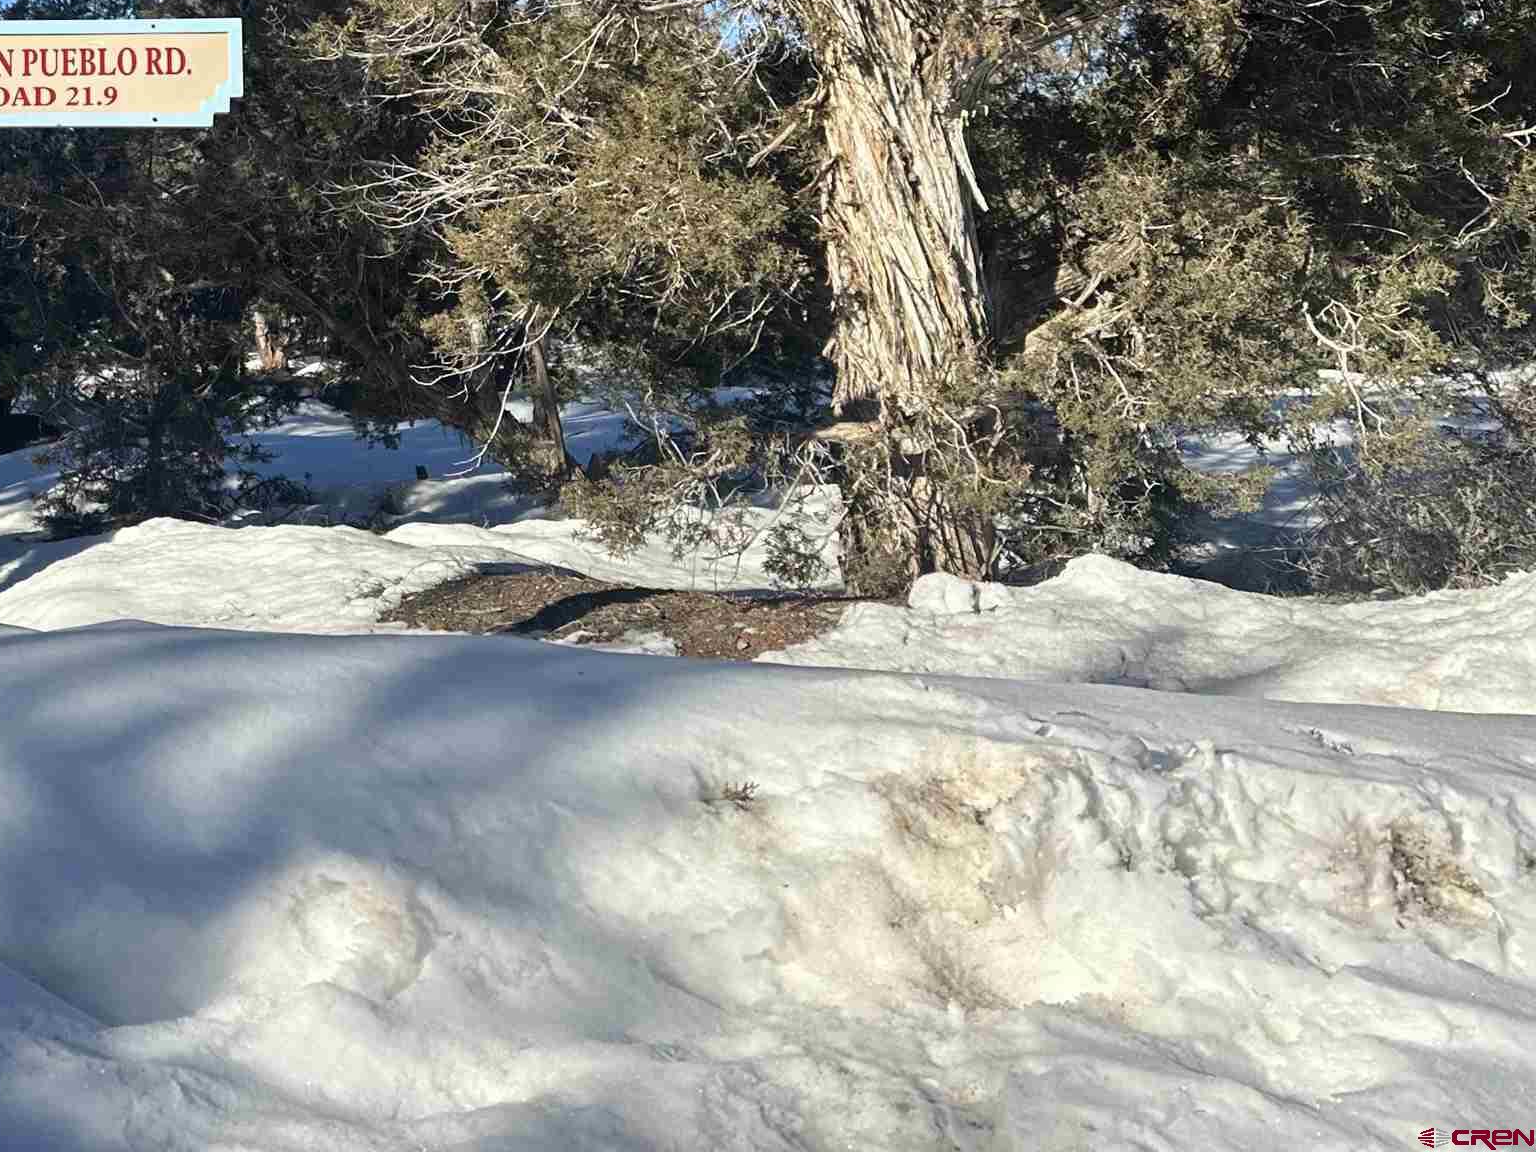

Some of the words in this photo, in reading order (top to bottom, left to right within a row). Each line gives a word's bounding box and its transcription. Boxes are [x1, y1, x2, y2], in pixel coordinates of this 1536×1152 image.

[21, 46, 138, 78] PUEBLO
[145, 46, 193, 76] RD.
[65, 85, 119, 107] 21.9
